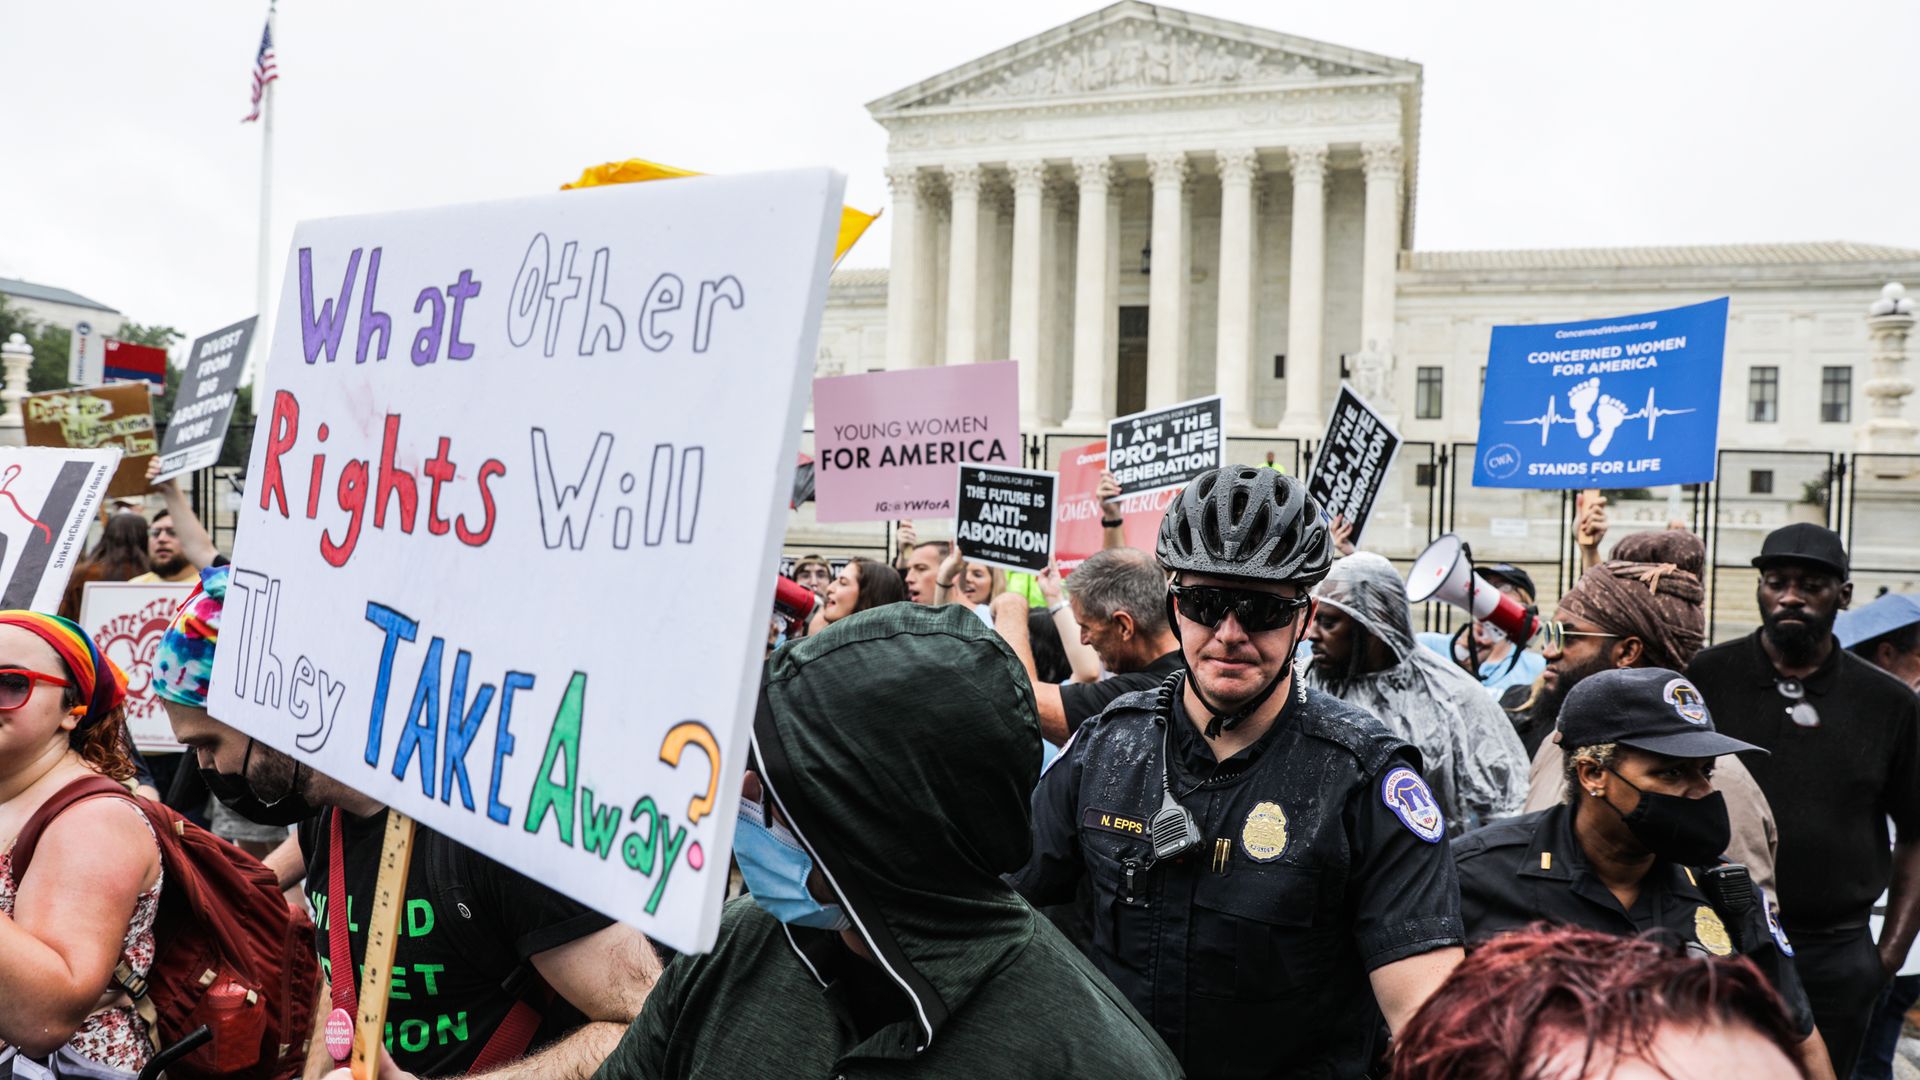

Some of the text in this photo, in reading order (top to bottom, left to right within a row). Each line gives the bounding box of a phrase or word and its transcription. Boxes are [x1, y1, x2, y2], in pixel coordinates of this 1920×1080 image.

[299, 232, 744, 366] What Other
[200, 328, 244, 359] DIVEST
[1555, 320, 1657, 339] ConcernedWomen.org
[196, 352, 233, 379] FROM
[1527, 336, 1687, 364] CONCERNED WOMEN
[1552, 356, 1658, 376] FOR AMERICA
[196, 376, 219, 398] BIG
[170, 391, 233, 427] ABORTION
[175, 417, 214, 445] NOW!
[834, 416, 988, 441] YOUNG WOMEN
[1116, 411, 1213, 448] I AM THE
[821, 439, 1007, 471] FOR AMERICA
[1110, 427, 1219, 470] PRO-LIFE
[1316, 490, 1328, 504] I
[1323, 452, 1341, 490] AM
[1335, 404, 1359, 448] THE
[1489, 453, 1514, 469] CWA
[259, 388, 704, 568] Rights Will
[1113, 450, 1216, 486] GENERATION
[1326, 409, 1376, 520] PRO-LIFE
[1342, 427, 1389, 524] ENERATION
[1528, 458, 1661, 476] STANDS FOR LIFE
[875, 502, 892, 513] IG:
[965, 484, 1045, 509] THE FUTURE IS
[54, 465, 108, 569] StrikeForChoice.org/donate
[978, 502, 1028, 527] ANTI-
[958, 520, 1049, 554] ABORTION
[233, 567, 722, 916] They TAKE Away?
[1101, 815, 1143, 834] N. EPPS
